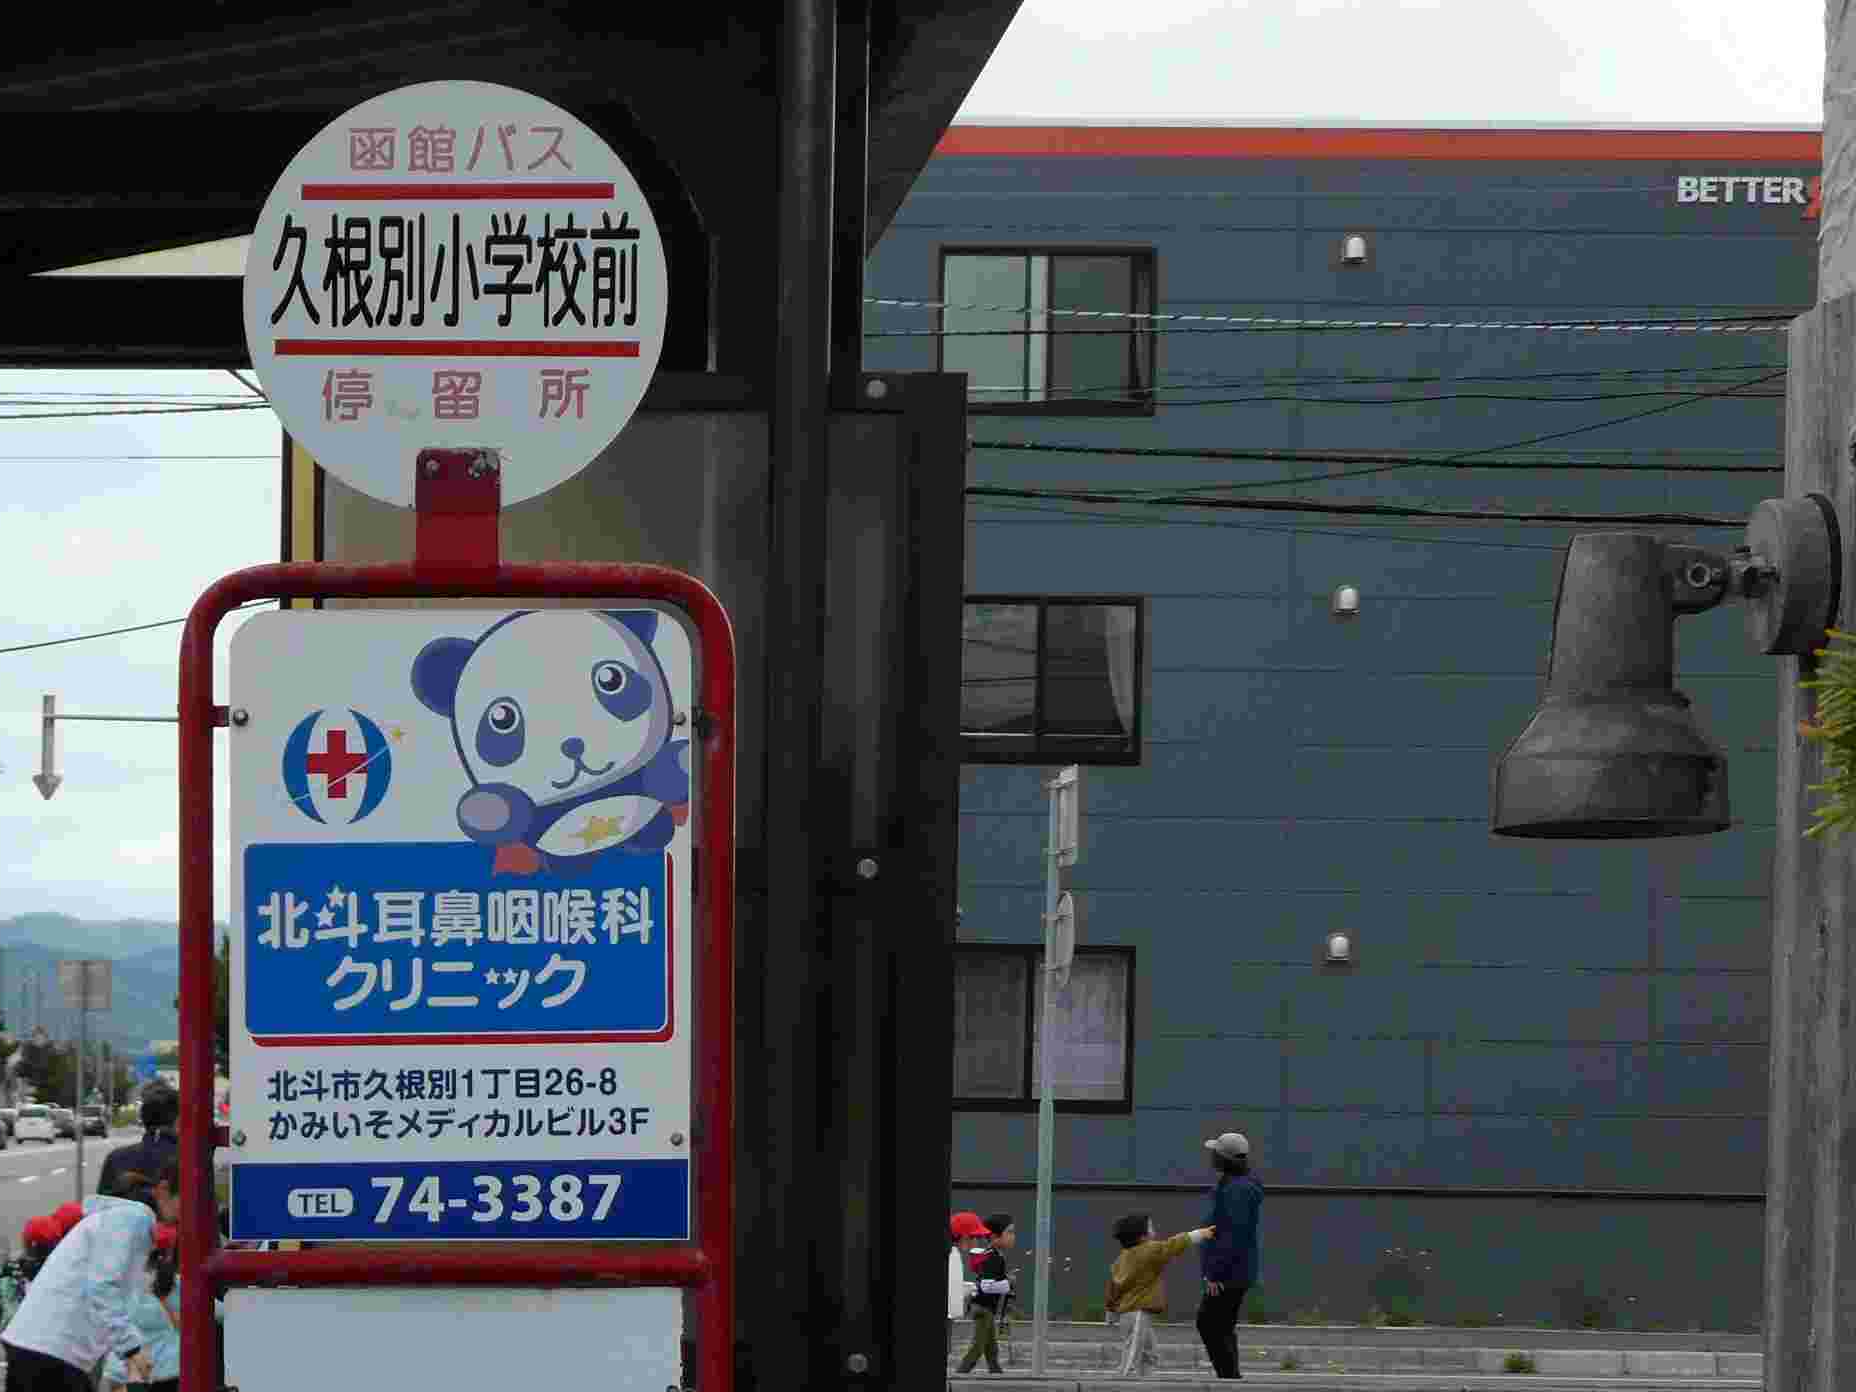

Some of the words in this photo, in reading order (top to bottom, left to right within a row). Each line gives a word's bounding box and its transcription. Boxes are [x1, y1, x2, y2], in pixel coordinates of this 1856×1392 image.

[348, 123, 574, 174] 函館バス
[1676, 176, 1807, 204] BETTER
[270, 212, 641, 328] 久根別小学校前
[322, 368, 591, 421] 停留所
[257, 883, 654, 948] 北斗耳鼻咽喉科
[326, 953, 586, 1011] クリニック
[267, 1067, 618, 1102] 北斗市久根別1丁目26-8
[268, 1106, 650, 1140] かみいそメディカルビル3F
[296, 1192, 346, 1215] TEL
[370, 1174, 623, 1224] 74-3387
